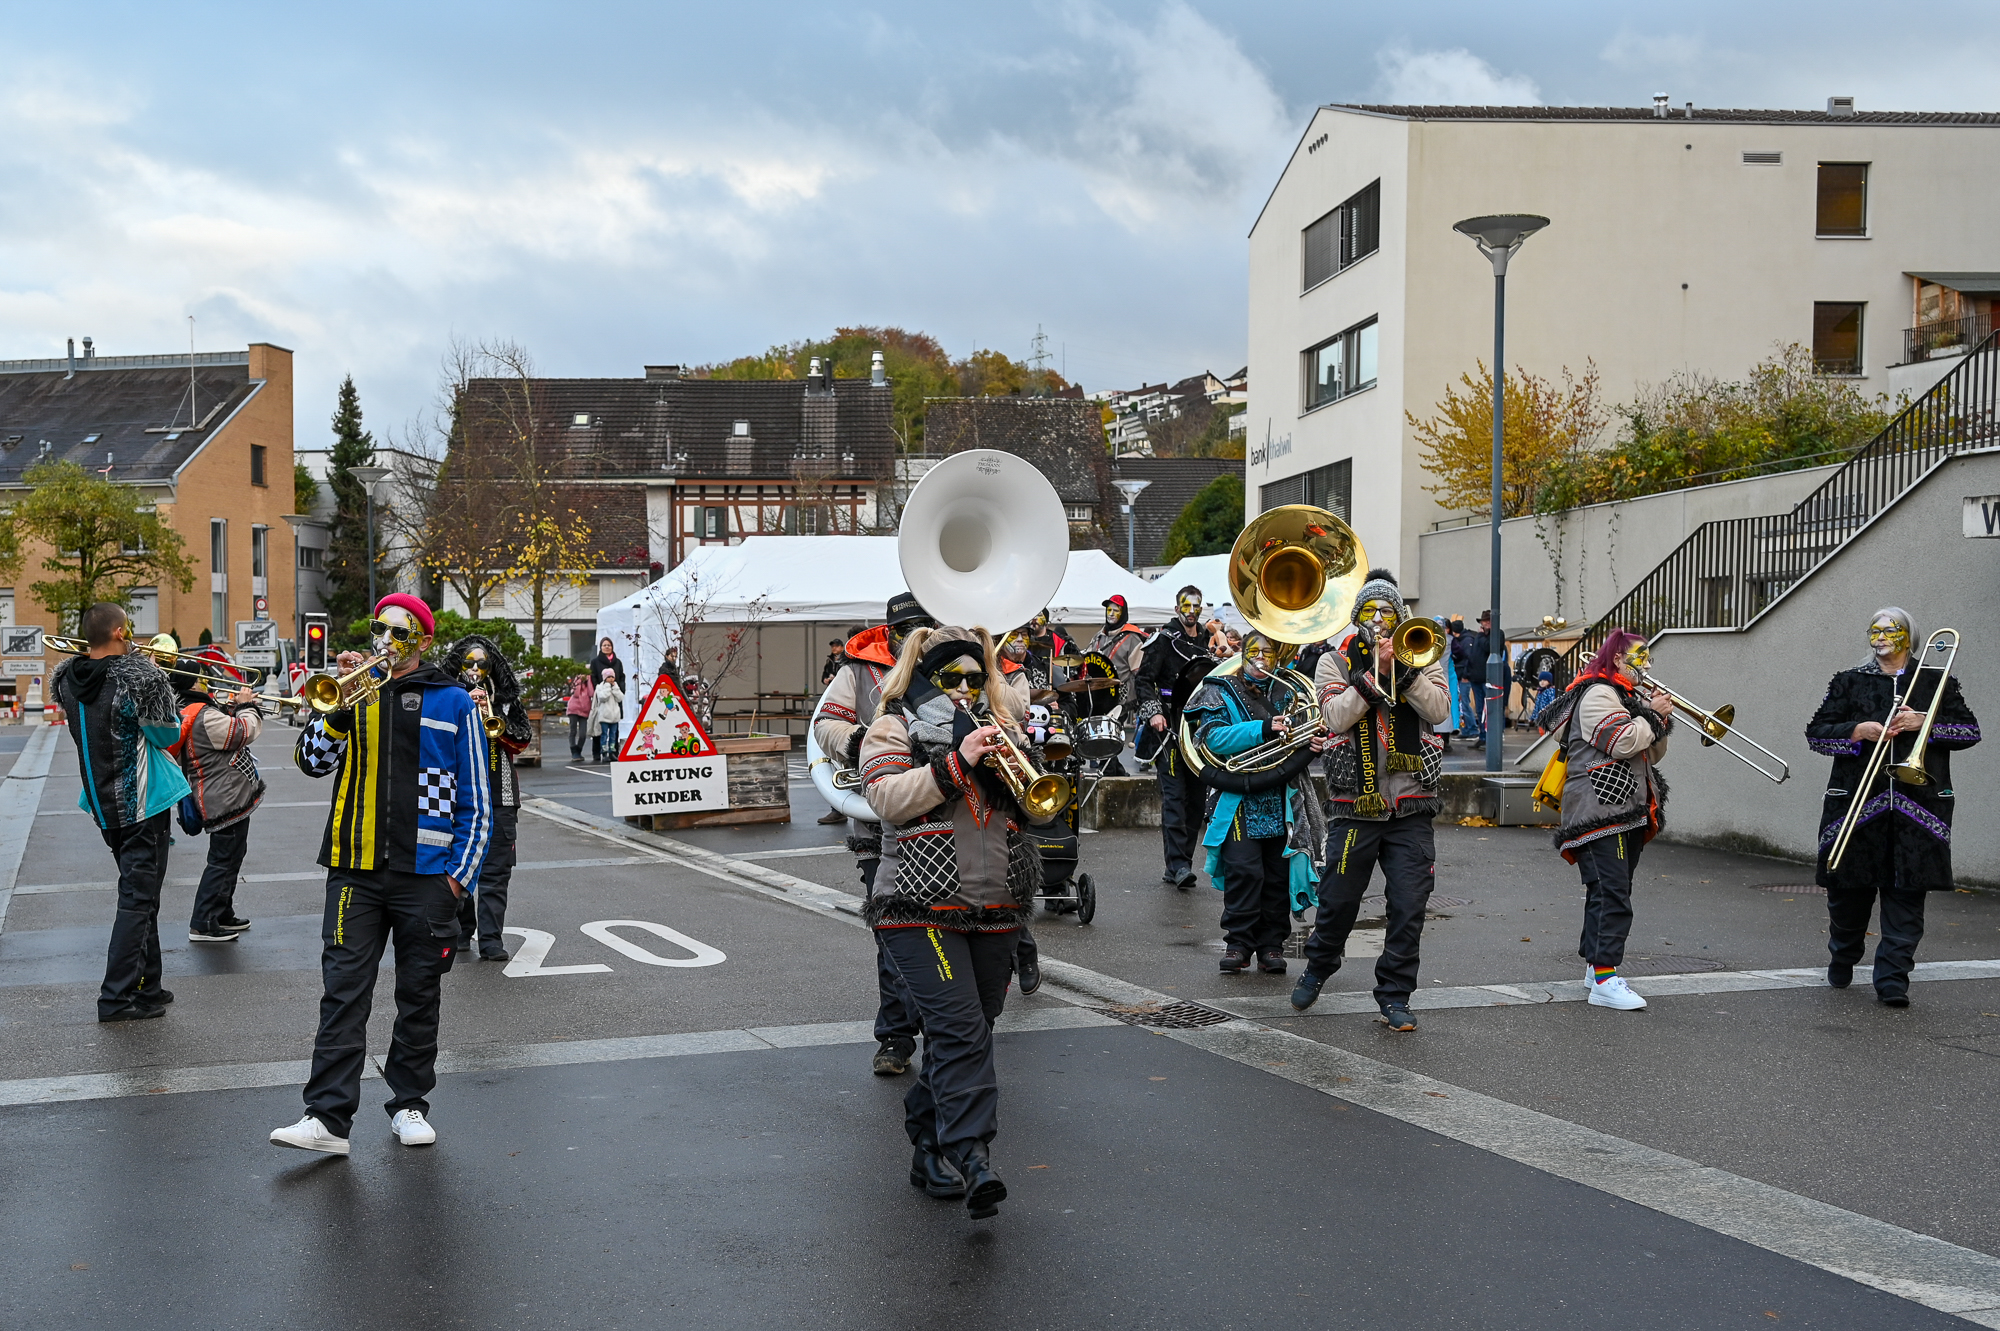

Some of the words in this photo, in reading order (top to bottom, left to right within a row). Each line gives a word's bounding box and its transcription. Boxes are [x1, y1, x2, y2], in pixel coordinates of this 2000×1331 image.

[1251, 442, 1266, 466] bank
[1270, 432, 1292, 460] thalwil
[627, 766, 713, 783] ACHTUNG
[634, 789, 702, 805] KINDER
[502, 920, 727, 978] 20
